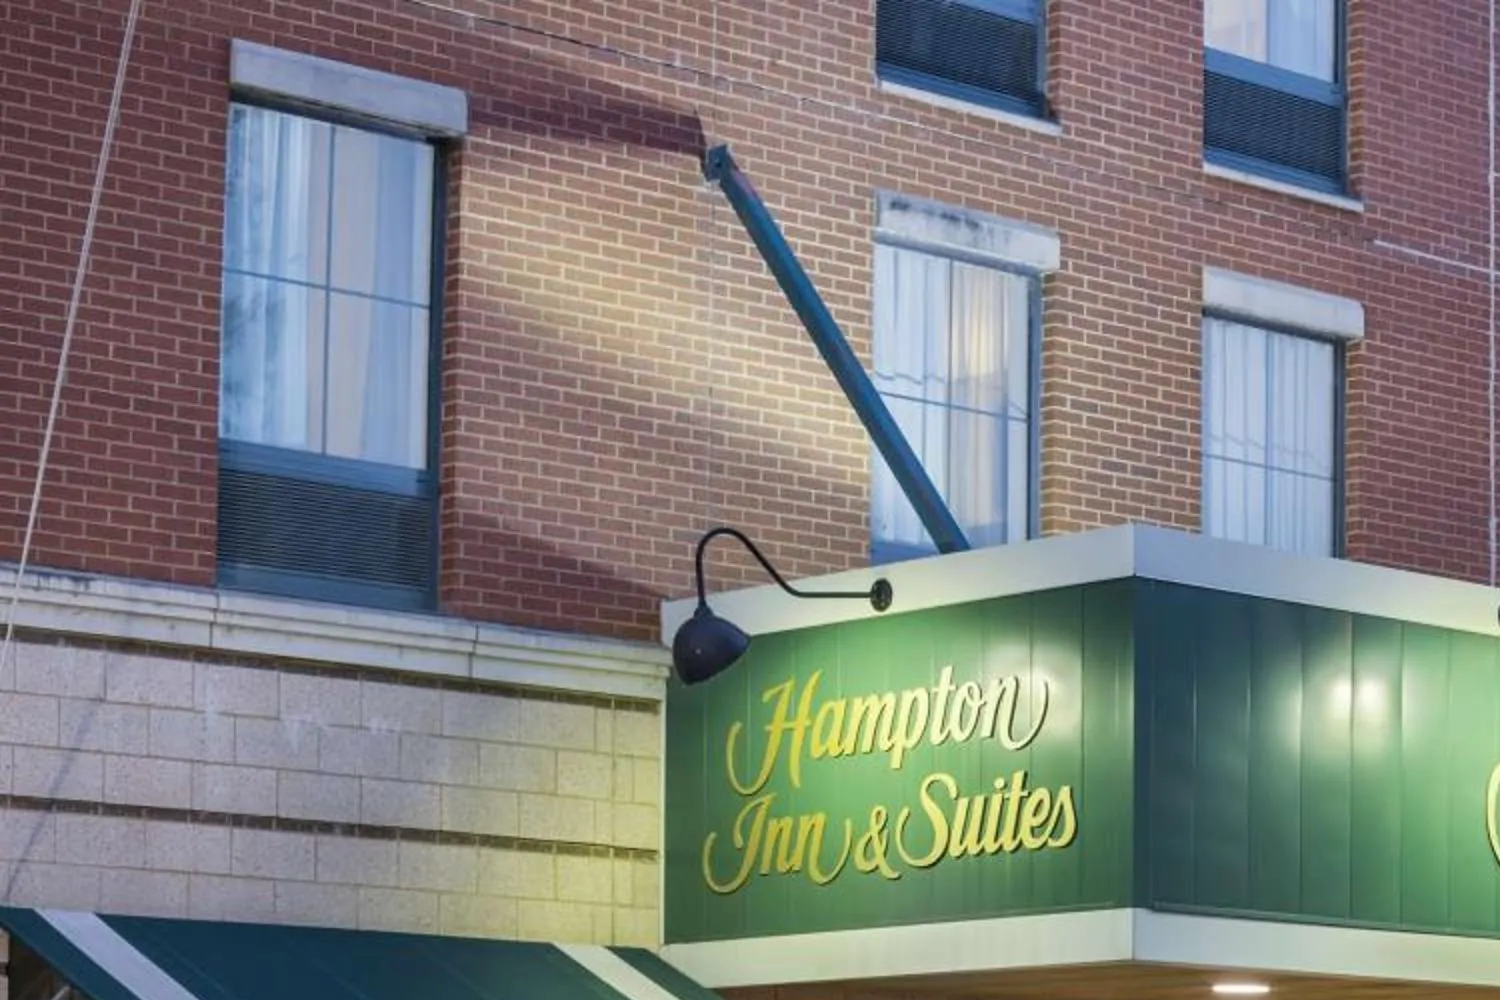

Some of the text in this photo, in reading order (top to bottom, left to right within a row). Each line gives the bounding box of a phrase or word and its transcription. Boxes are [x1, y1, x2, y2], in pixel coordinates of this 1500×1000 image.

[726, 665, 1049, 795] Hampton
[704, 770, 1078, 893] Inn & Suites
